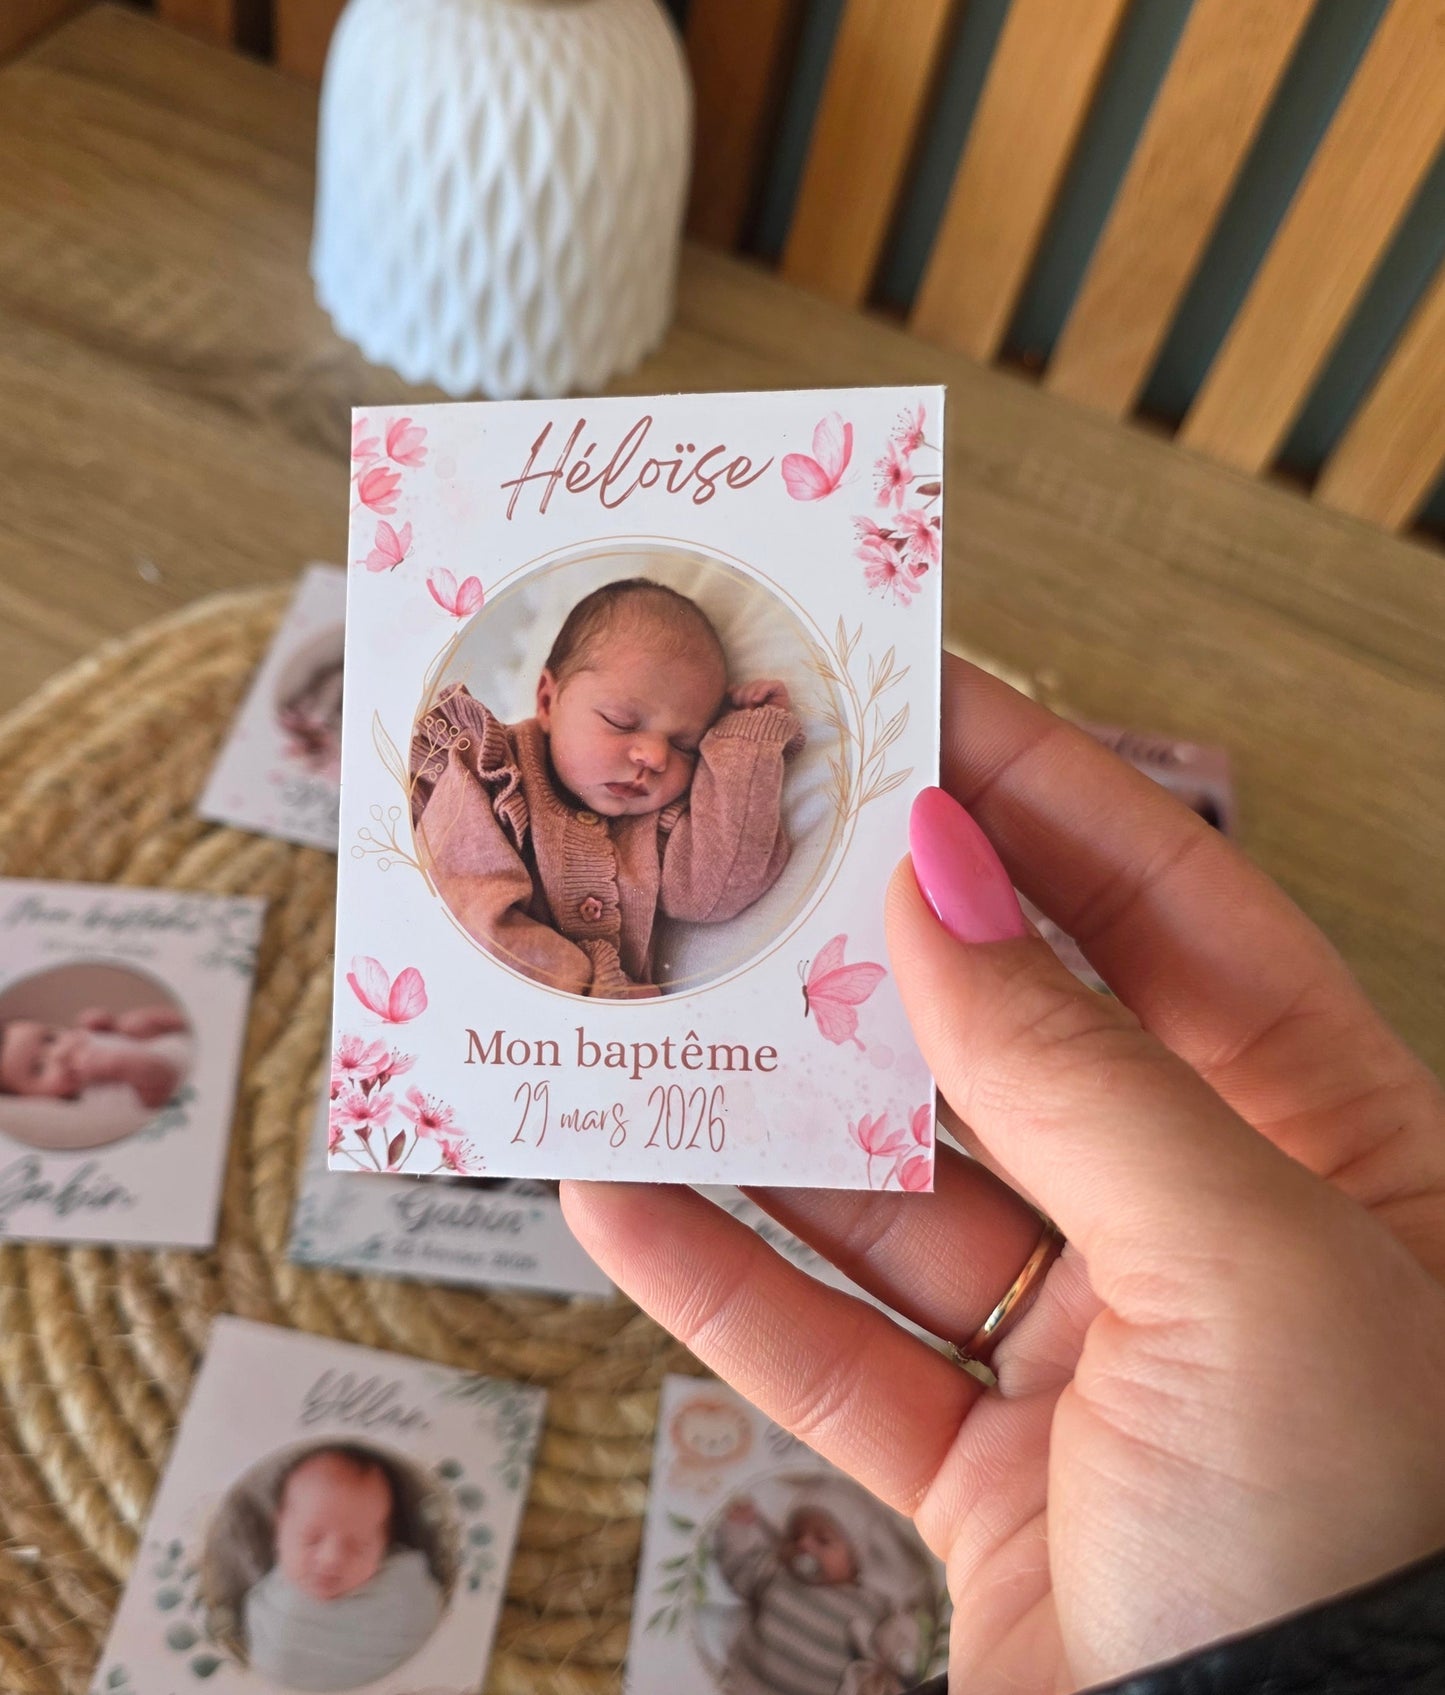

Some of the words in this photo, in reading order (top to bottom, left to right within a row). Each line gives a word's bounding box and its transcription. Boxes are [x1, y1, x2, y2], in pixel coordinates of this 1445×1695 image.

[500, 415, 774, 520] Héloïse
[464, 1029, 562, 1066] Mon
[575, 1026, 778, 1080] baptême
[510, 1080, 550, 1147] 29
[560, 1103, 630, 1148] mars
[644, 1084, 725, 1152] 2026
